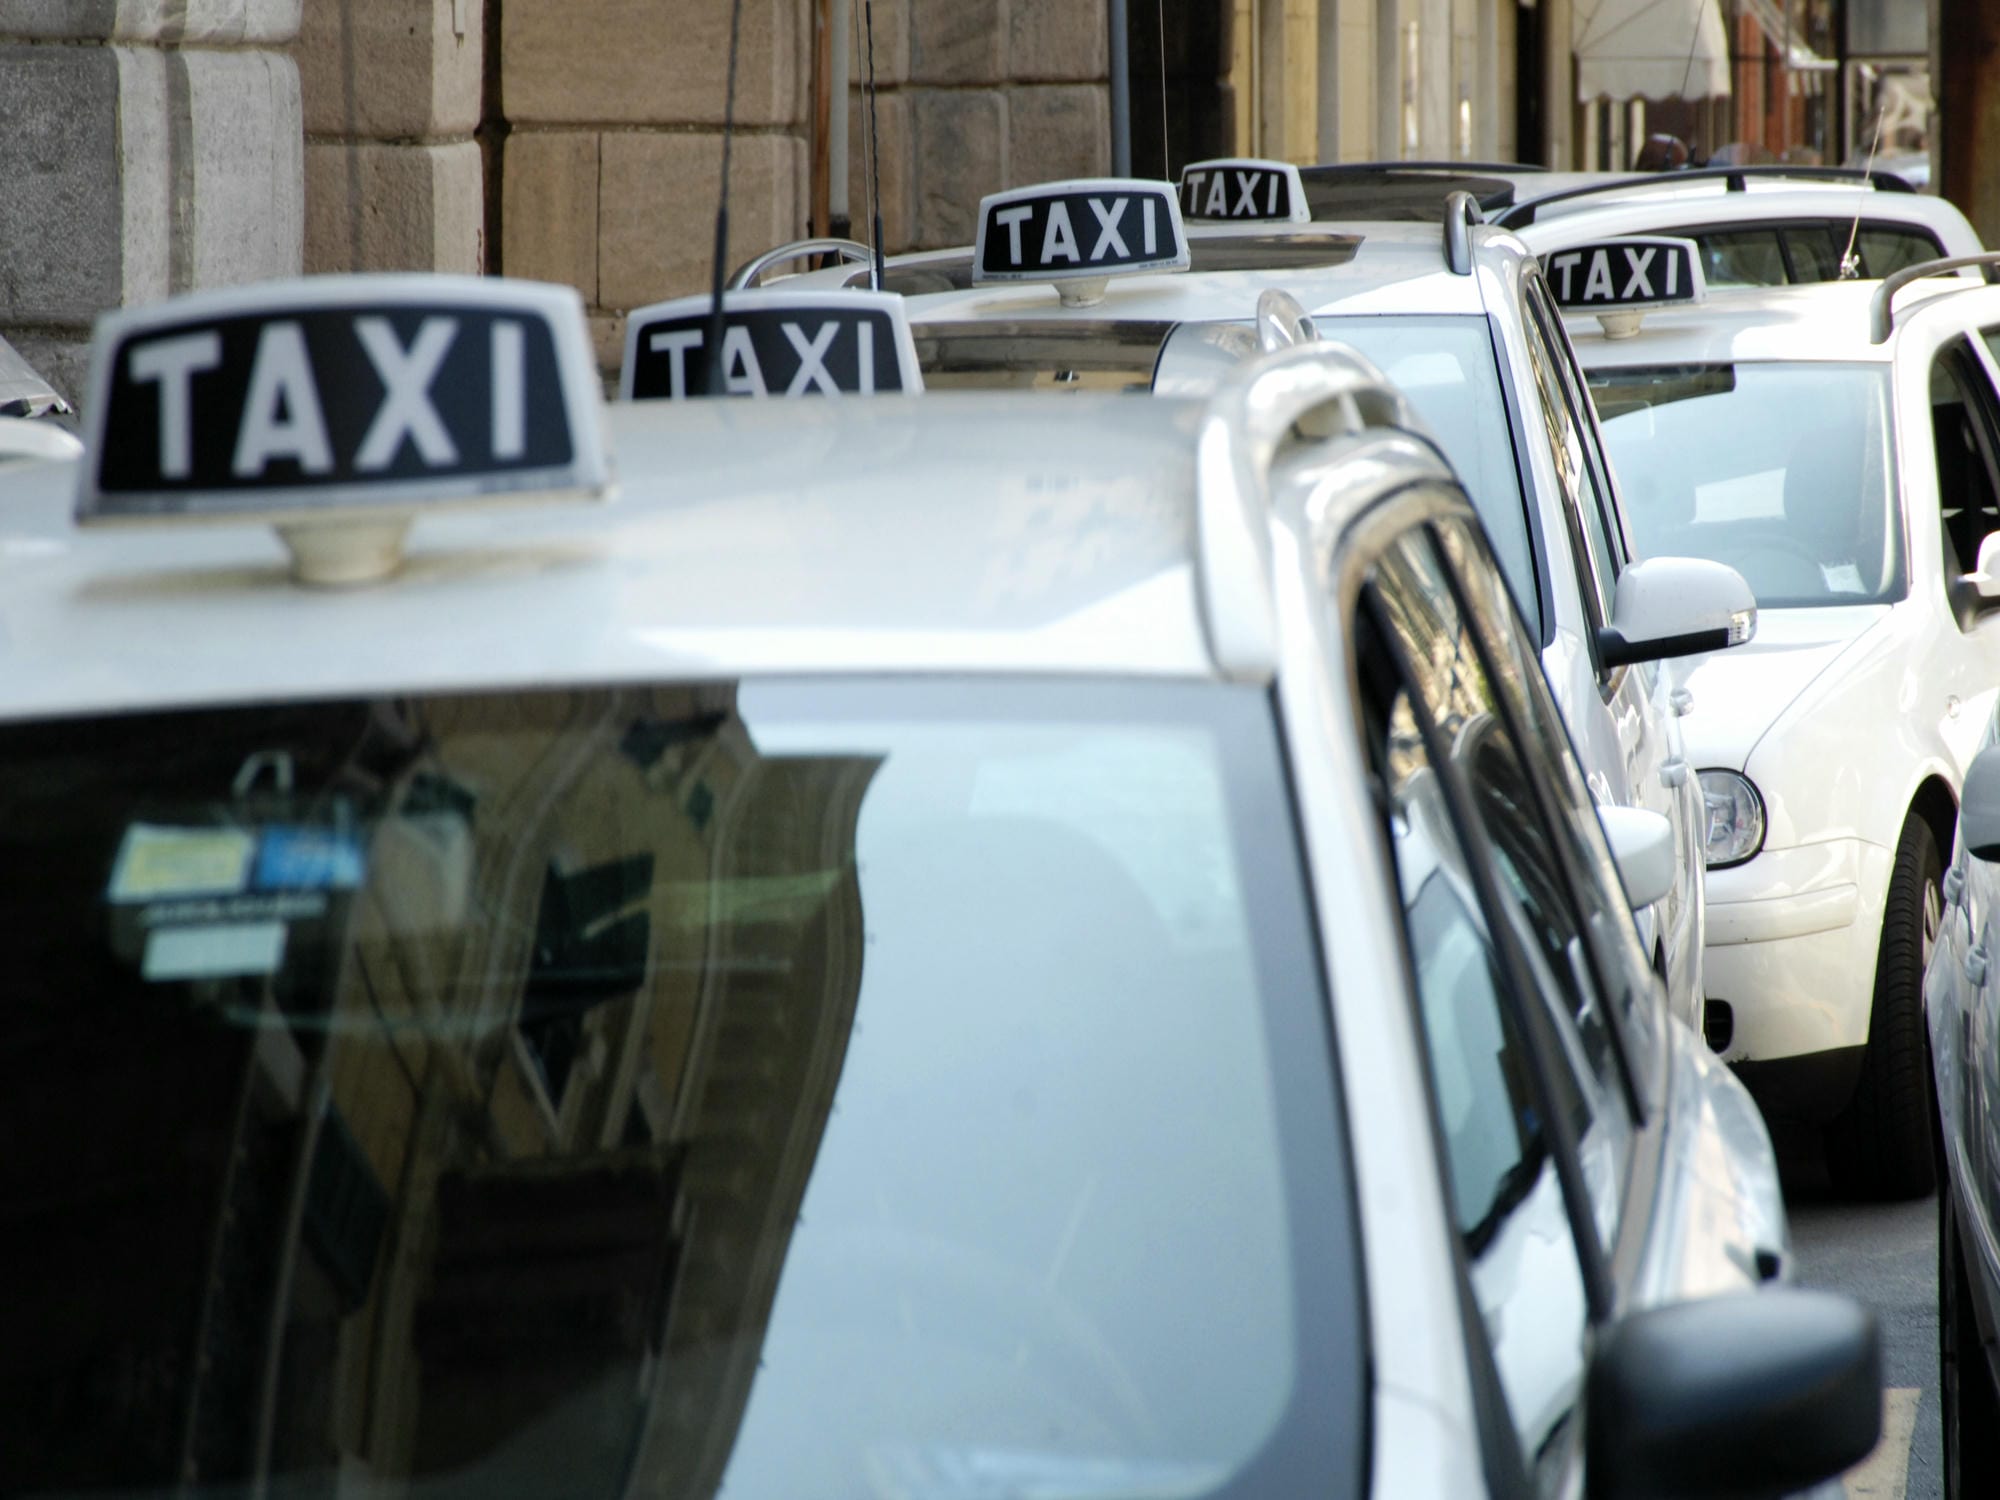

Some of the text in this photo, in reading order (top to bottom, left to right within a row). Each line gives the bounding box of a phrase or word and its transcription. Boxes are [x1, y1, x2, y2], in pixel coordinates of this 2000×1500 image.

[1187, 171, 1279, 216] TAXI
[997, 198, 1157, 265] TAXI
[1554, 247, 1679, 301] TAXI
[650, 320, 875, 400] TAXI
[129, 315, 526, 481] TAXI
